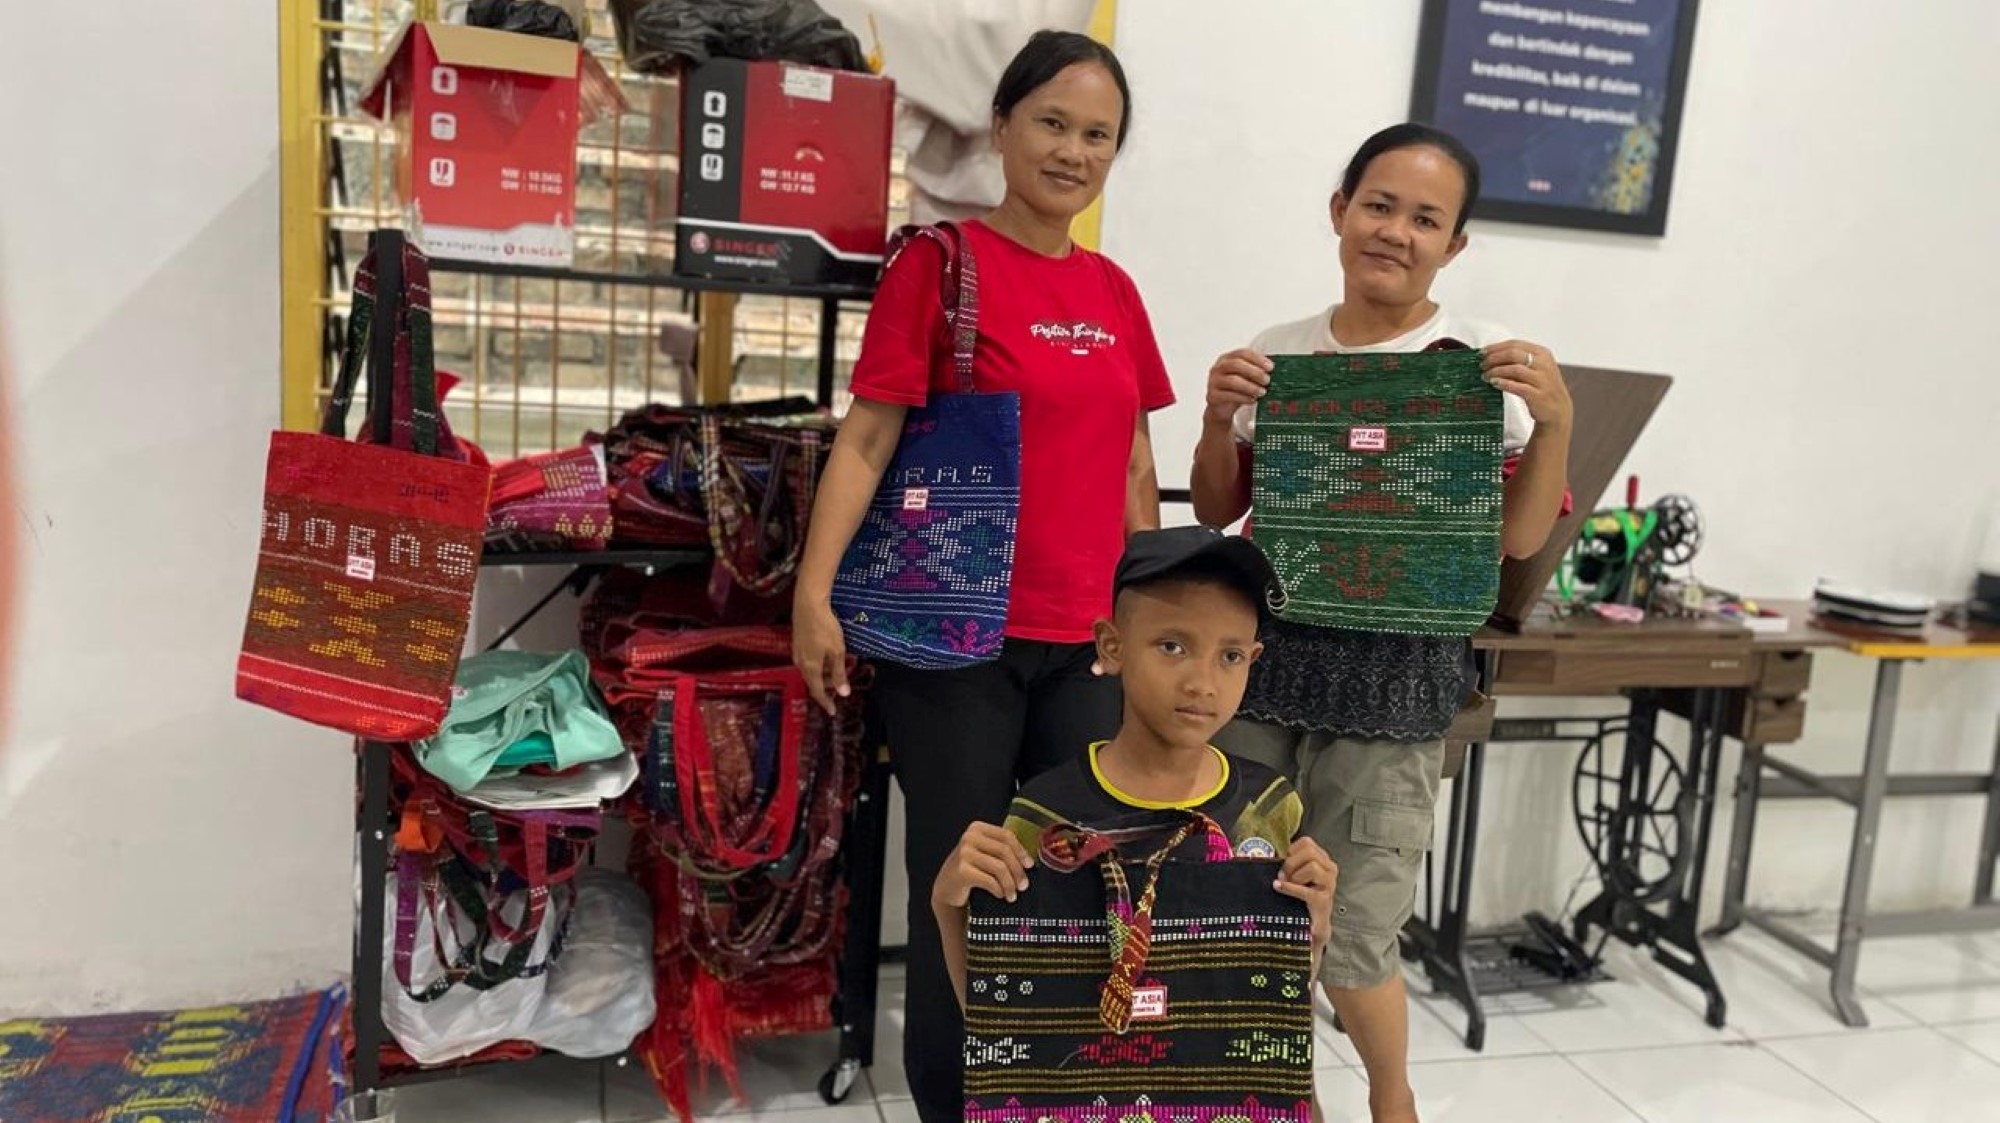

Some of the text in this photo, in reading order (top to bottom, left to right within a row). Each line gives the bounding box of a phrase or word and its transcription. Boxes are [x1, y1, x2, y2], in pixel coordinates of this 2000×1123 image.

[1488, 31, 1634, 65] dan bertindak dengan
[1552, 70, 1581, 89] baik
[1583, 75, 1599, 91] di
[1600, 77, 1641, 96] dalam
[1523, 98, 1539, 114] di
[1541, 100, 1568, 117] luar
[501, 168, 520, 179] NW
[761, 168, 777, 179] NW
[760, 180, 777, 191] GW
